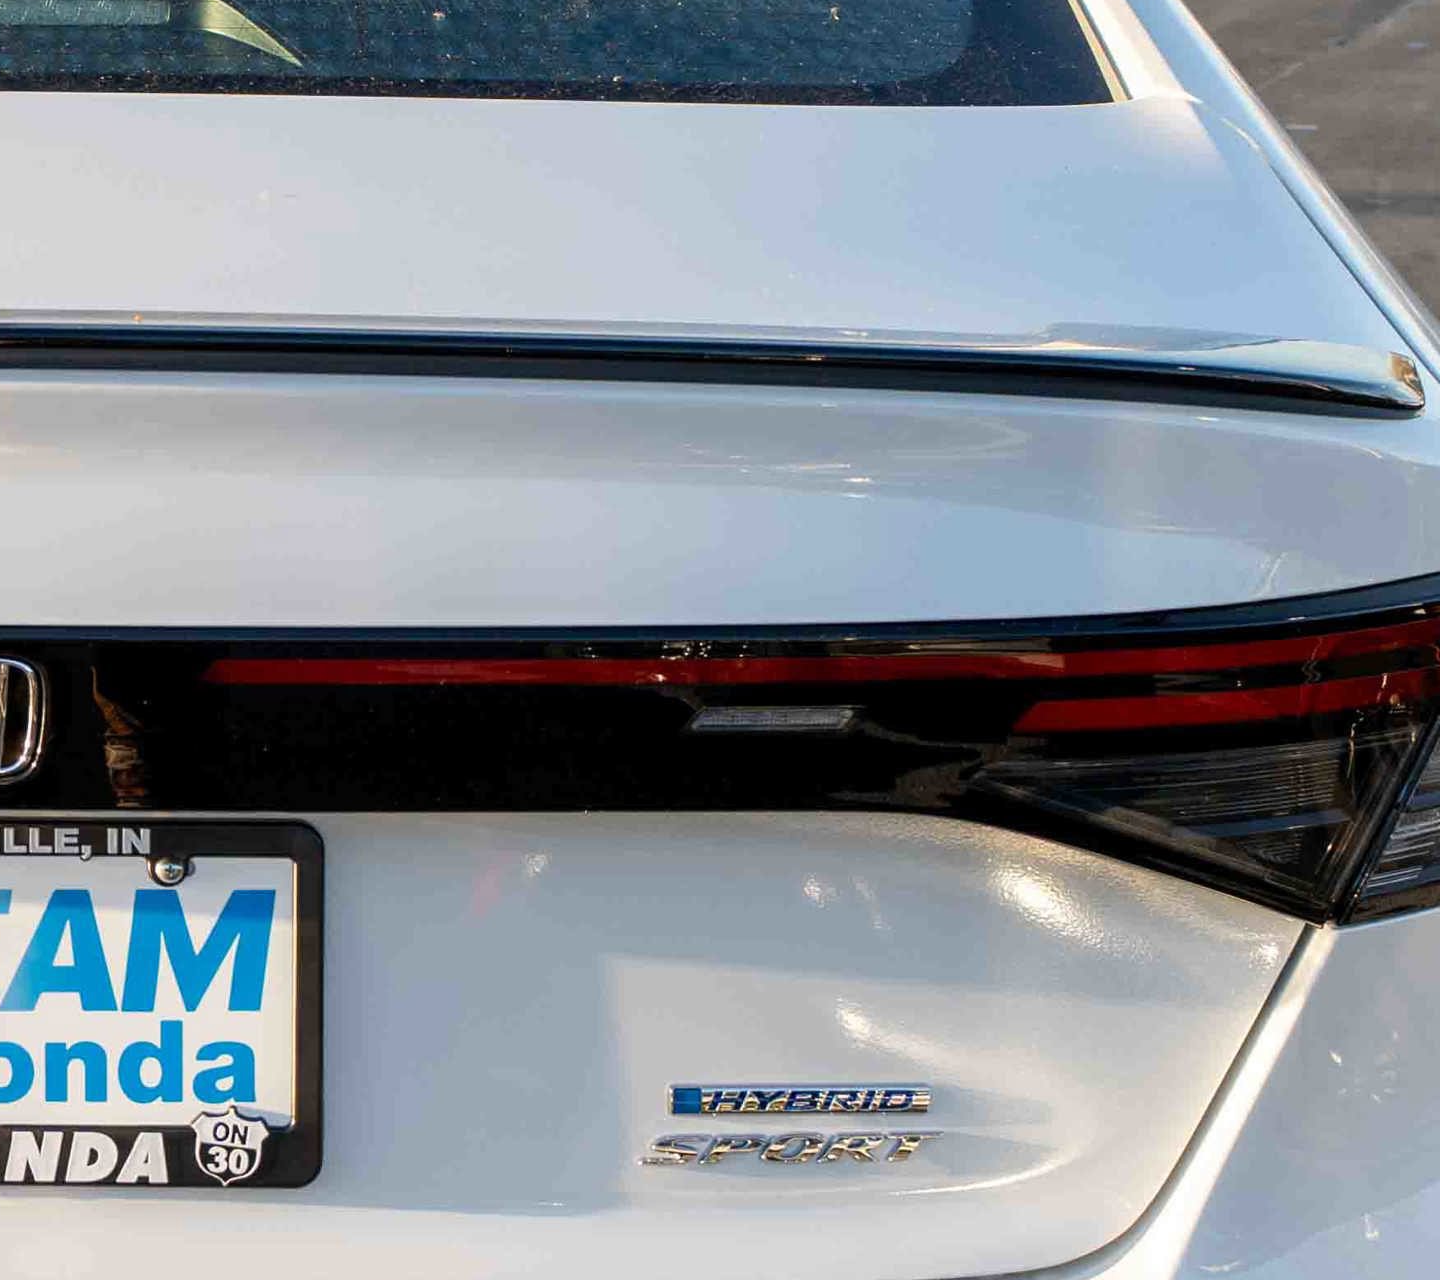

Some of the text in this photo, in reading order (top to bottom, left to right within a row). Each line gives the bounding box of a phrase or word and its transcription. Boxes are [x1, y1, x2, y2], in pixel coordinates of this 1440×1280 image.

[106, 827, 151, 855] IN
[706, 1088, 917, 1114] HYBRID
[212, 1121, 249, 1145] ON
[206, 1144, 250, 1175] 30
[638, 1130, 945, 1167] SPORT
